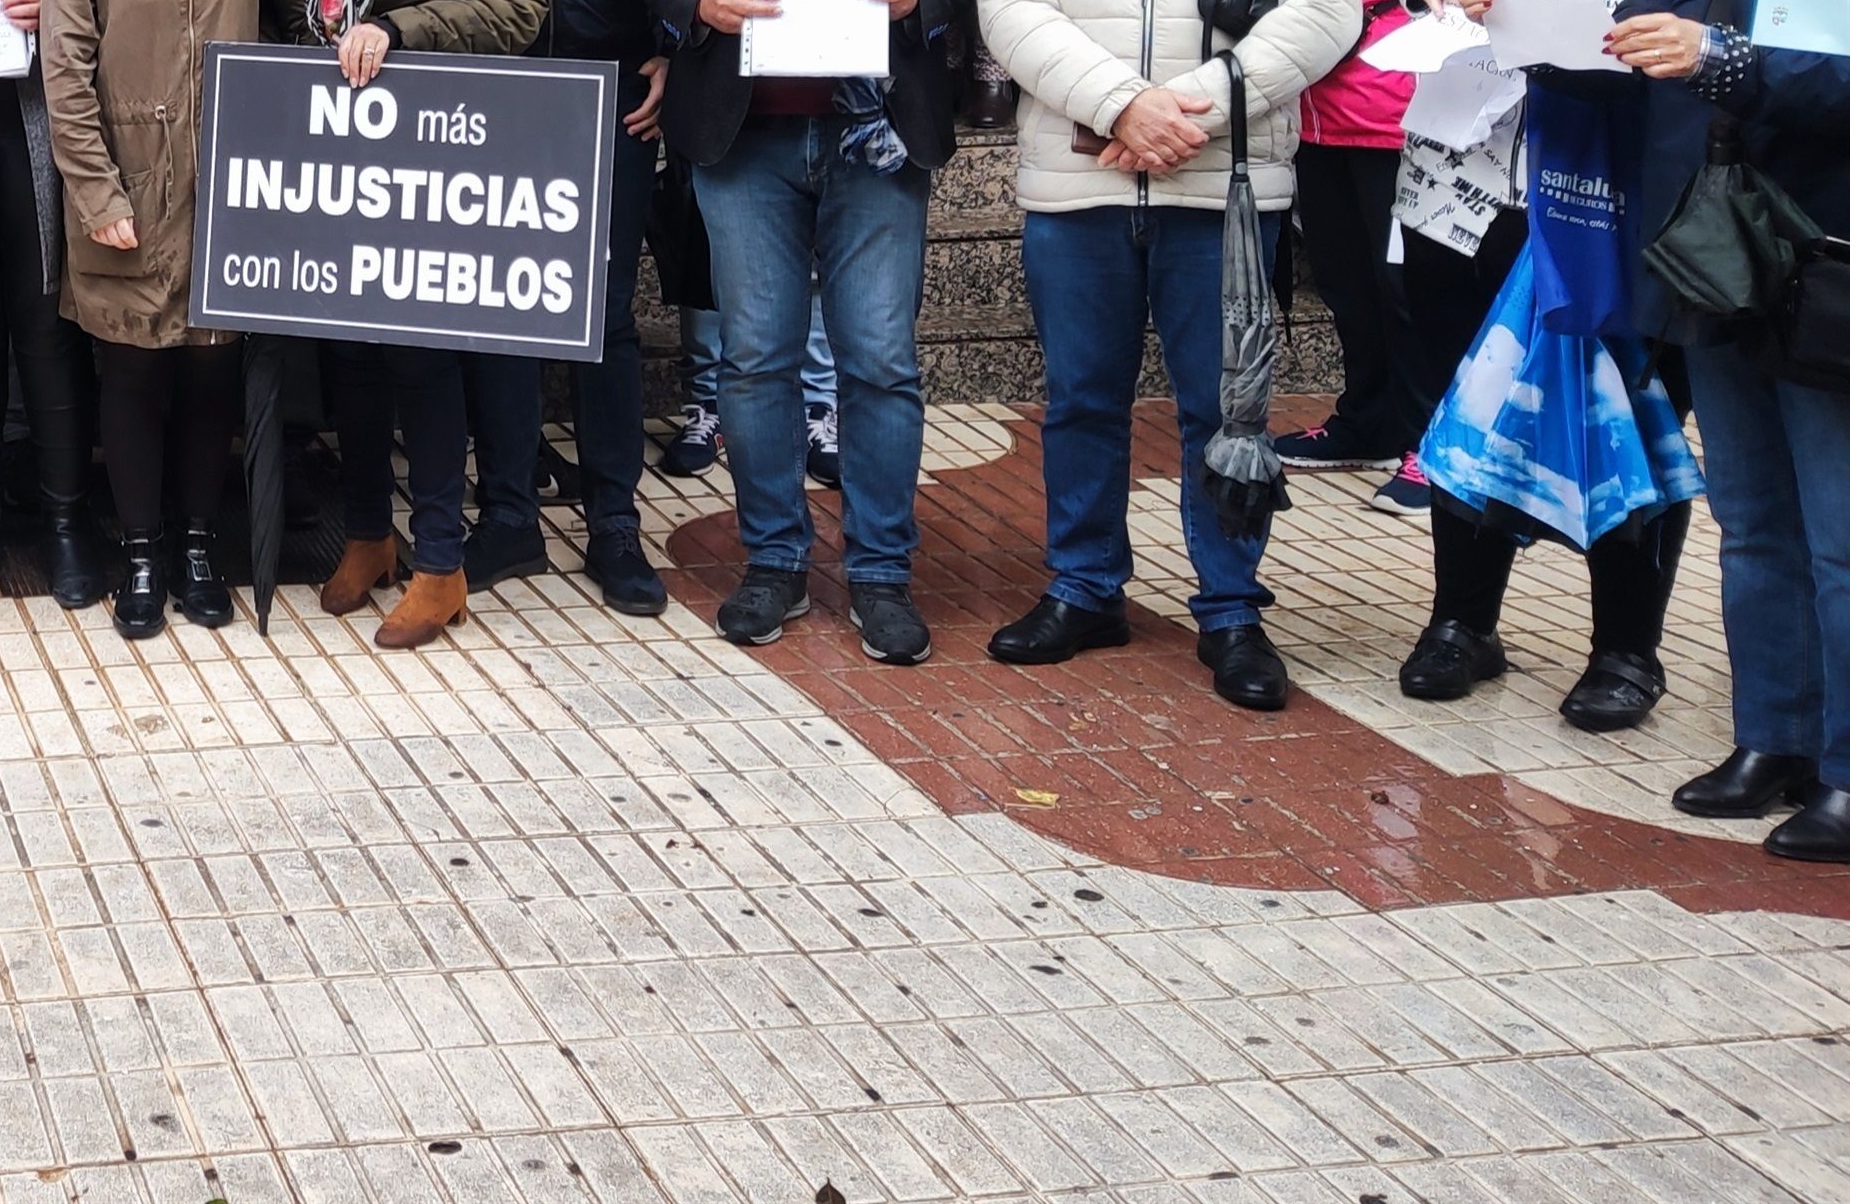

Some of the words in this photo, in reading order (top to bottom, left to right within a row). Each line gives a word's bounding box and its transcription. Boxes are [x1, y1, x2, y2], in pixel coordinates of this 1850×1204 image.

[309, 84, 398, 139] NO
[417, 103, 487, 146] más
[227, 157, 580, 233] INJUSTICIAS
[223, 253, 280, 289] con
[292, 251, 338, 294] los
[350, 245, 573, 313] PUEBLOS
